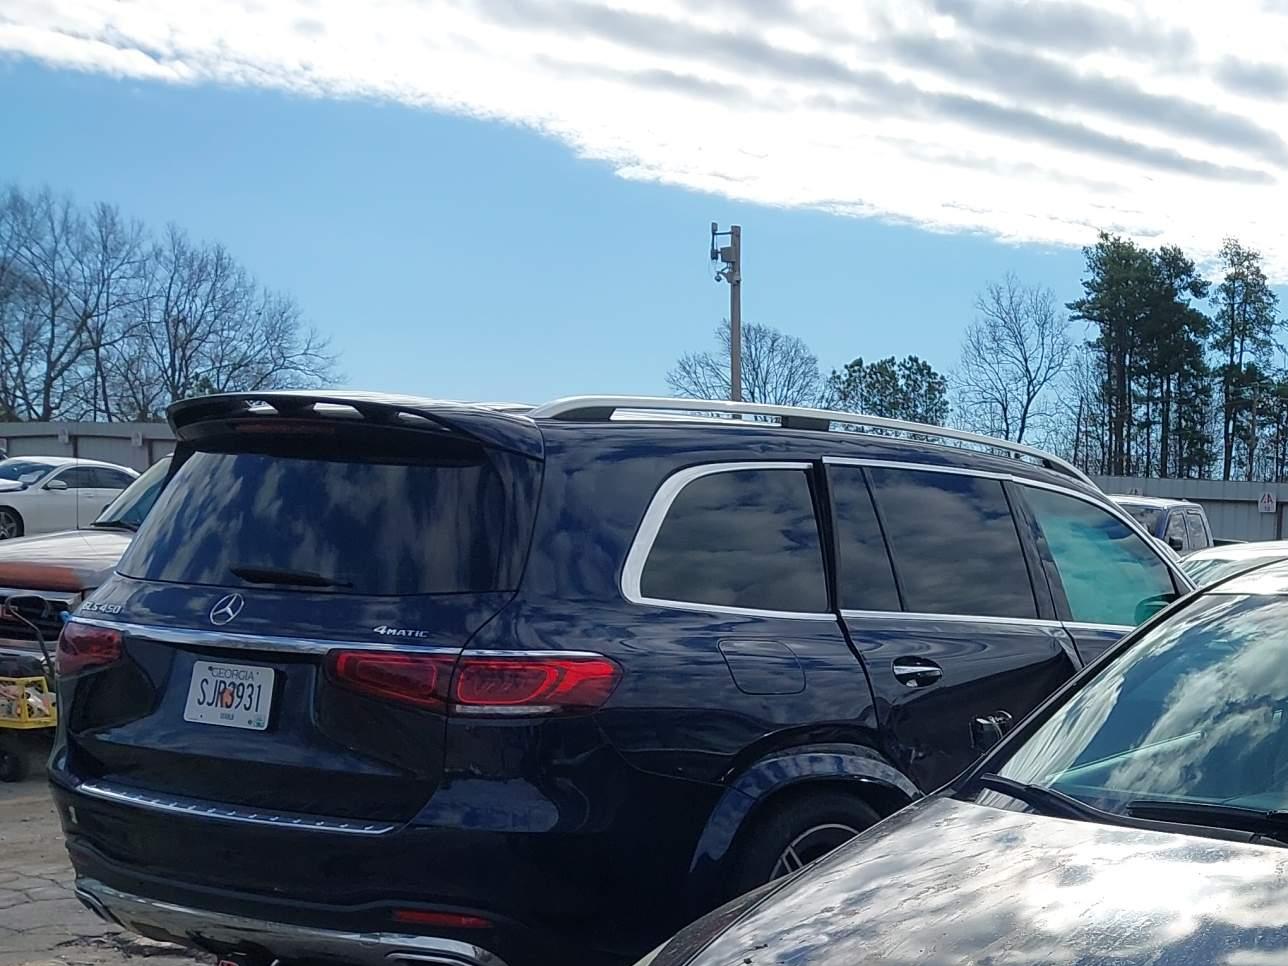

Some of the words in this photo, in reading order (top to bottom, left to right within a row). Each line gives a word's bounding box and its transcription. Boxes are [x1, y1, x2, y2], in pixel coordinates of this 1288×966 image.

[373, 625, 430, 638] 4MATIC
[210, 667, 255, 681] GEORGIA
[197, 678, 262, 713] SJR3931
